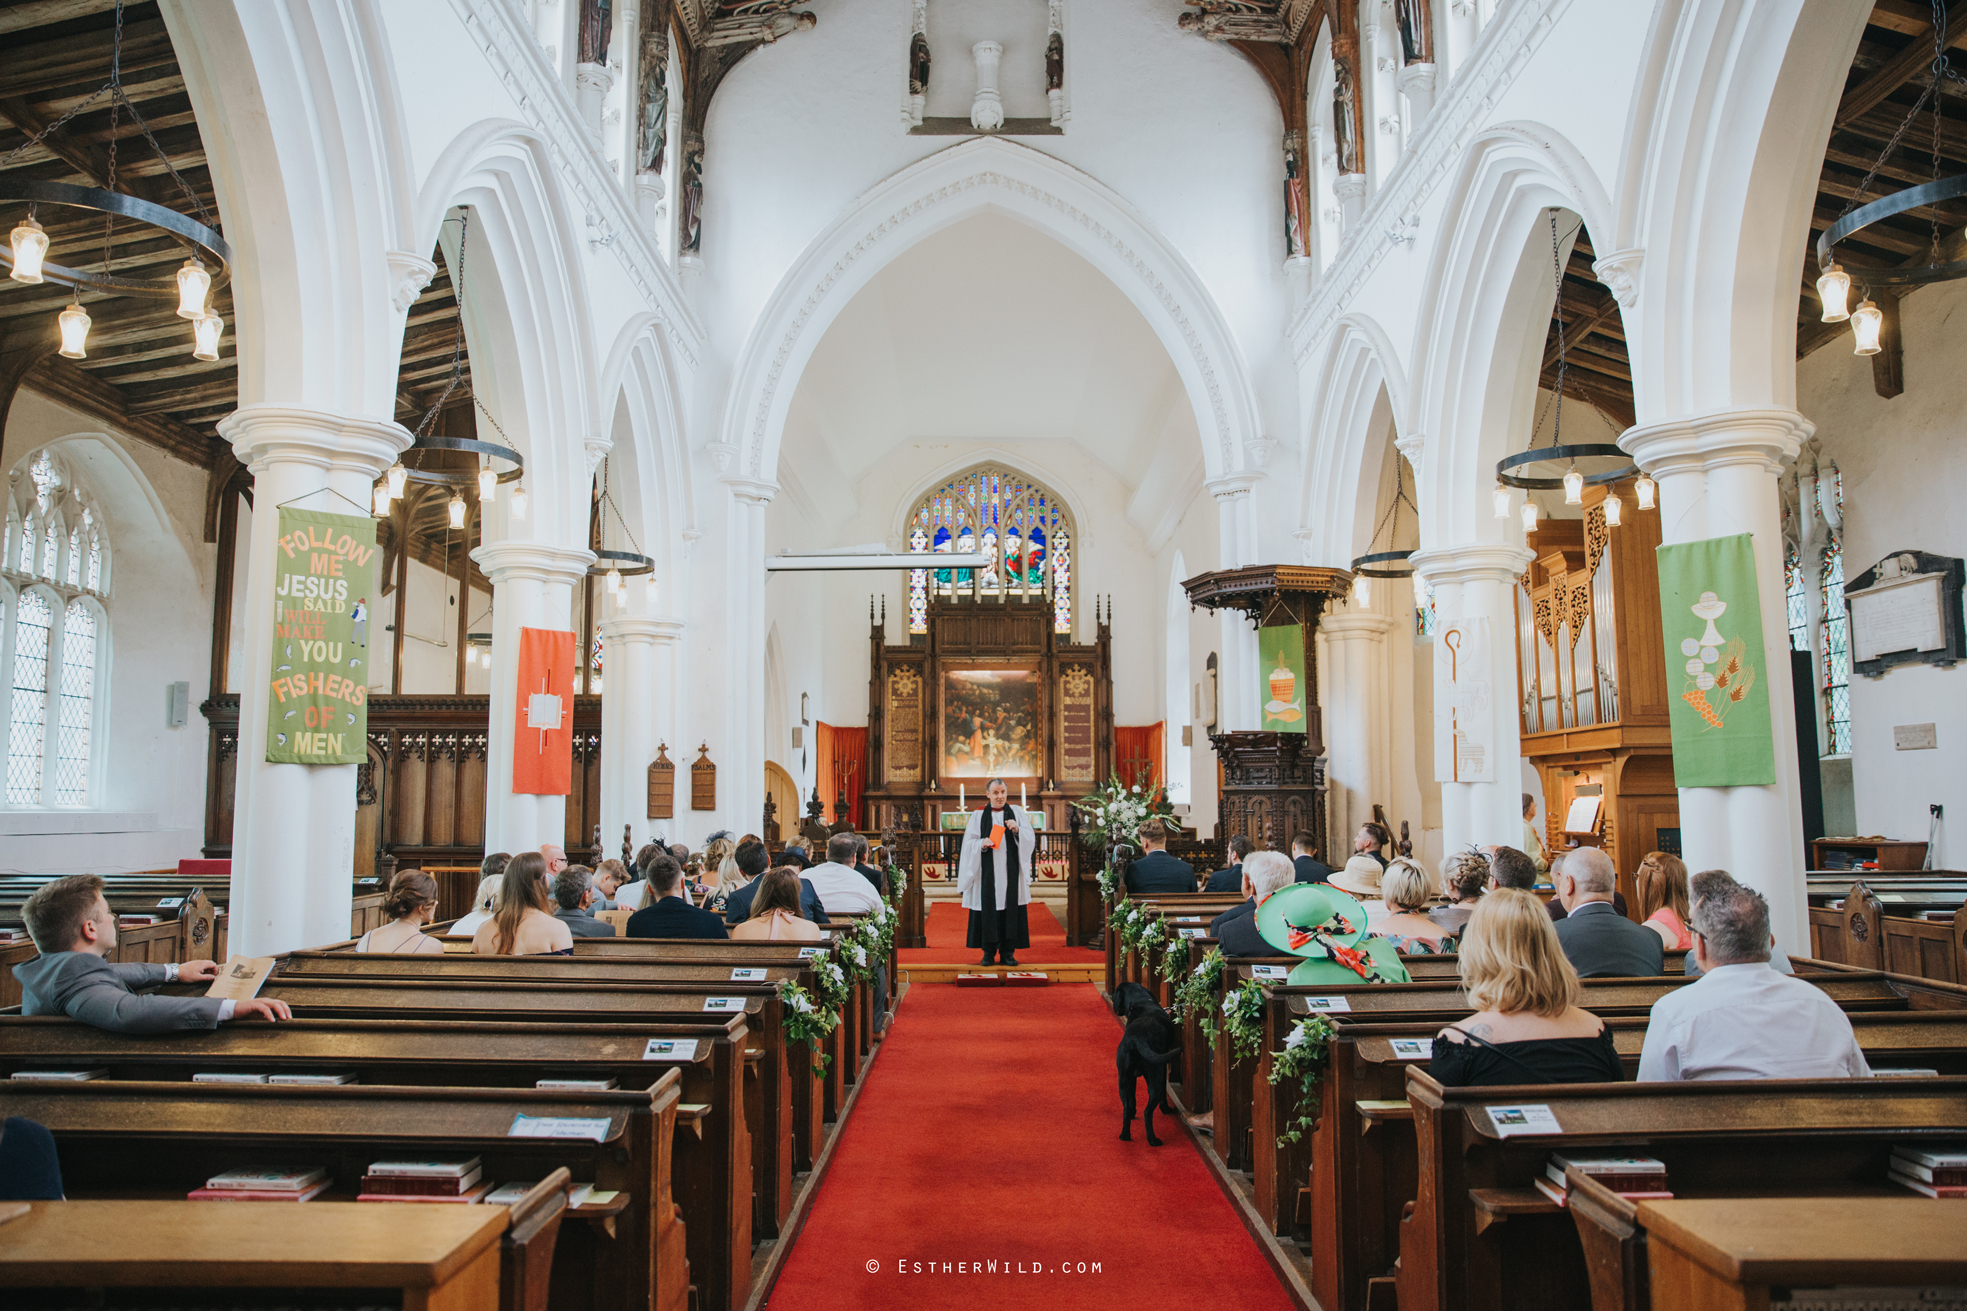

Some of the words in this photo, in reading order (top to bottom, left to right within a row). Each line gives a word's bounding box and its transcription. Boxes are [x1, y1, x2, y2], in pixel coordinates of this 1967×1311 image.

[278, 526, 374, 567] FOLLOW
[309, 552, 344, 577] ME
[276, 574, 348, 601] JESUS
[275, 600, 283, 622] I
[284, 609, 327, 626] WILL
[303, 597, 346, 614] SAID
[275, 624, 326, 640] MAKE
[299, 639, 343, 664] YOU
[271, 672, 367, 706] FISHERS
[304, 706, 335, 729] OF
[293, 732, 343, 756] MEN
[653, 762, 673, 770] HYMNS
